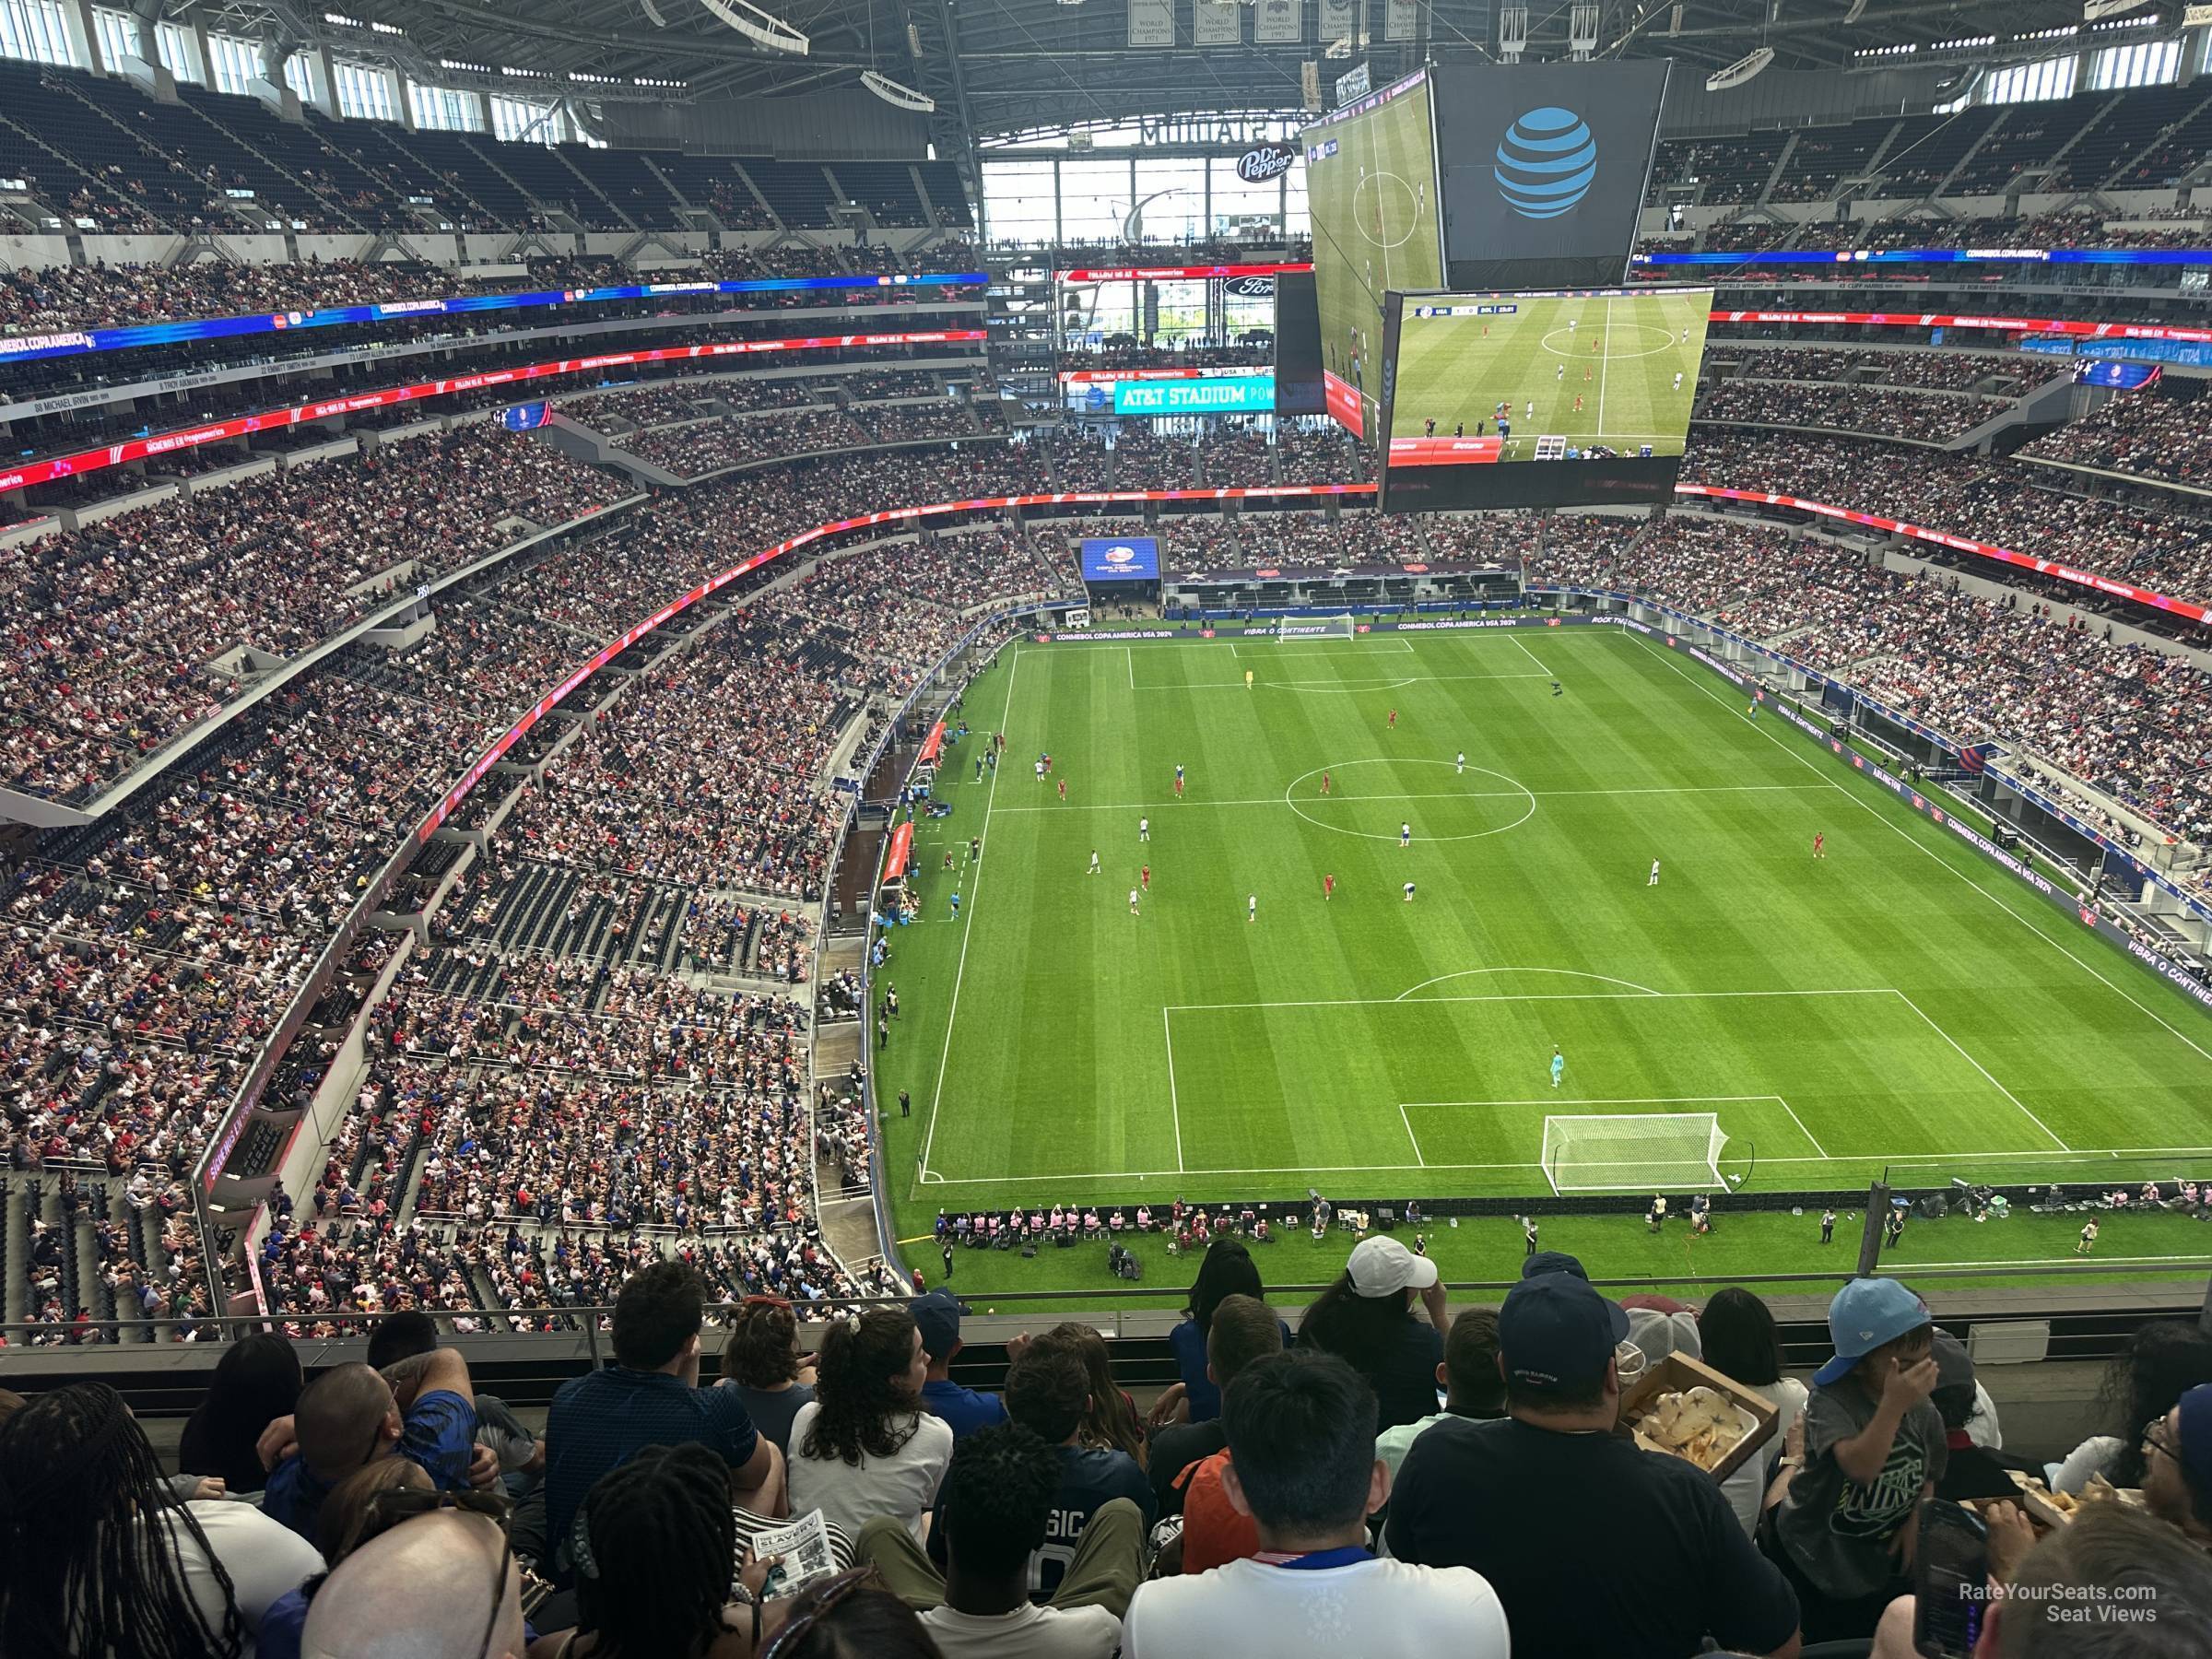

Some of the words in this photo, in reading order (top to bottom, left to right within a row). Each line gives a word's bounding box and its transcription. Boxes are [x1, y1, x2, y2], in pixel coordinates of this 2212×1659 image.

[1198, 26, 1237, 34] CHAMPIONS
[1260, 147, 1280, 163] Dr
[1240, 150, 1291, 178] Pepper
[371, 348, 385, 359] ALLEN
[286, 361, 301, 371] SMITH
[164, 380, 180, 391] TROY
[179, 377, 200, 389] AIKMAN
[35, 402, 43, 413] 88
[44, 397, 73, 411] MICHAEL
[73, 394, 89, 407] IRVIN
[1123, 387, 1165, 406] AT&T
[1169, 385, 1245, 406] STADIUM
[1391, 442, 1417, 451] etano
[1056, 633, 1094, 641] CONMEBOL
[1277, 626, 1326, 634] CONTINENTE
[1796, 714, 1824, 739] CONTINENTE
[1873, 767, 1901, 793] ARLINGTON
[1947, 818, 1979, 845] CONMEBOL
[2022, 867, 2035, 884] USA
[2035, 876, 2052, 895] 2024
[2128, 940, 2157, 966] VIBRA
[2158, 961, 2167, 971] O
